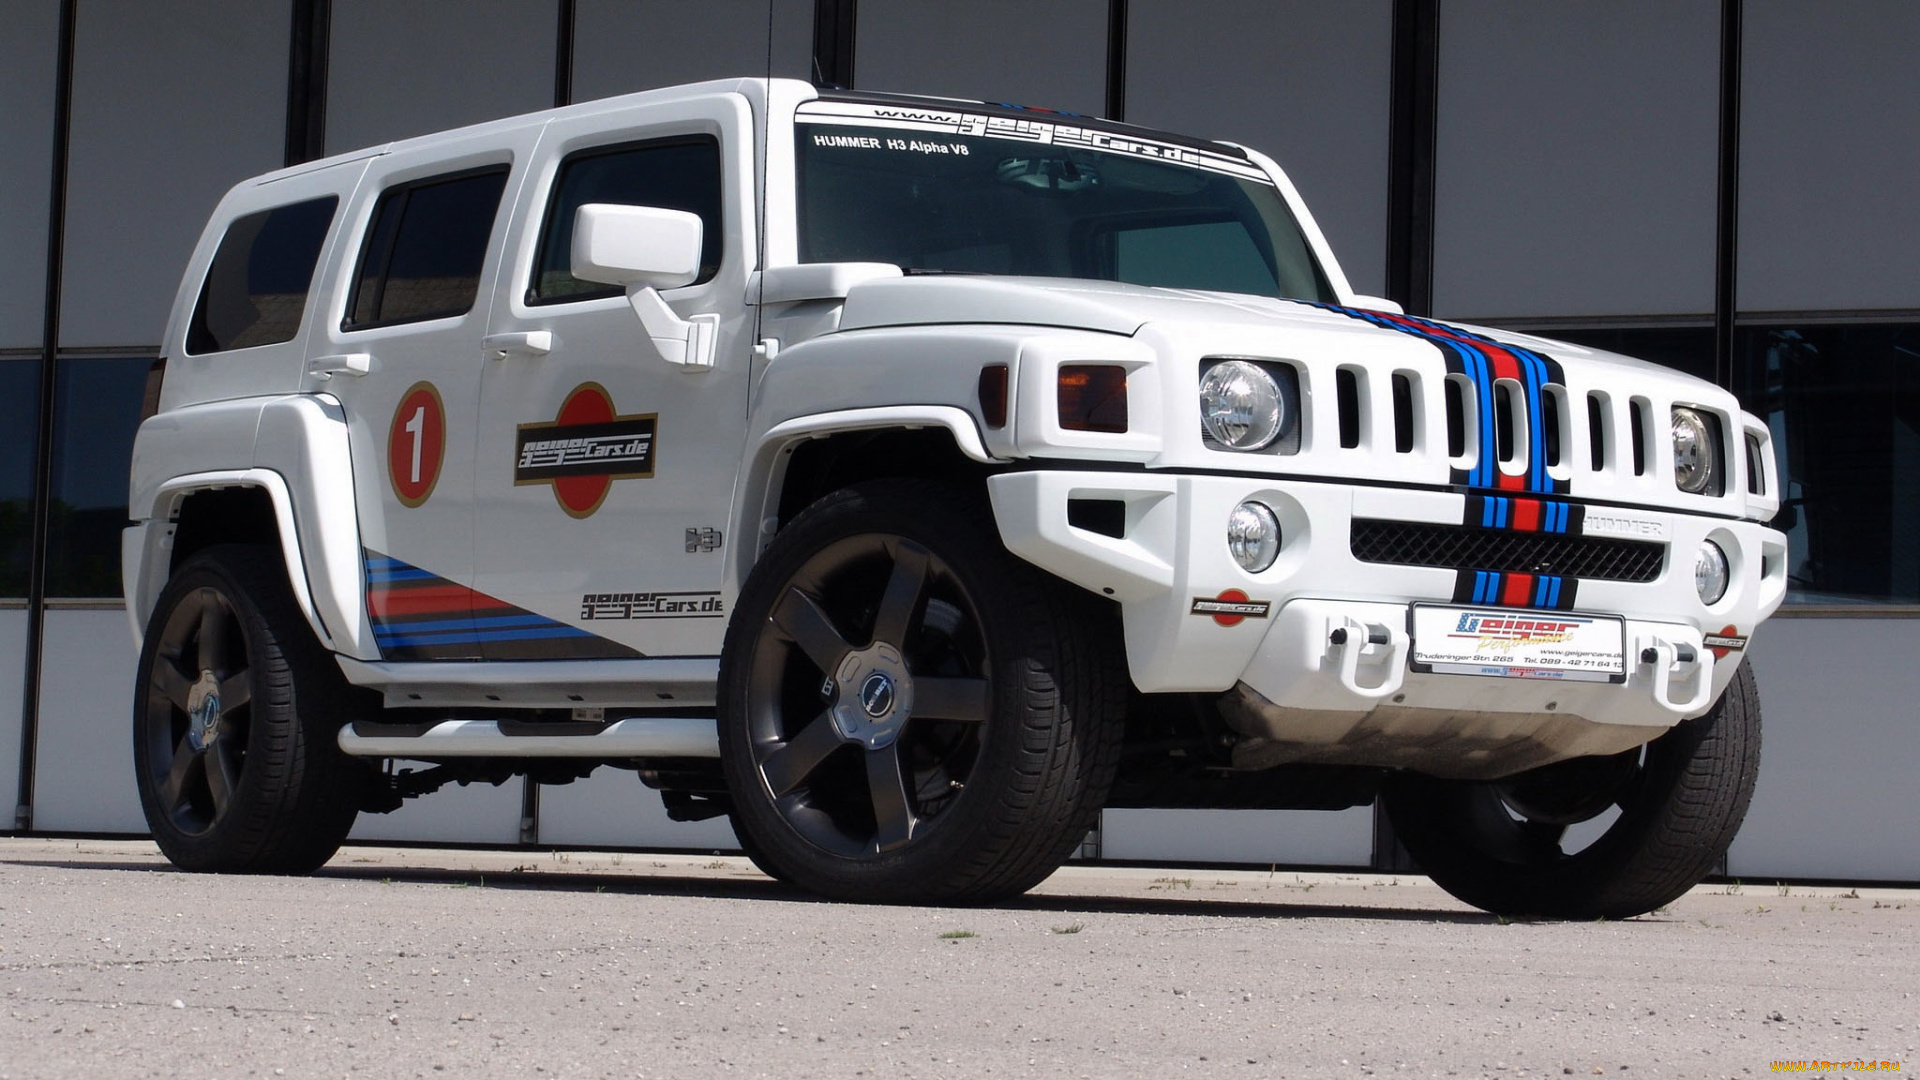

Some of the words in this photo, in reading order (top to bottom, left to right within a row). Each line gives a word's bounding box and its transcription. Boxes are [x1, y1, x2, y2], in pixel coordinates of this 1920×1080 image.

[814, 135, 882, 149] HUMMER
[887, 139, 906, 150] H3
[909, 140, 949, 155] Alpha
[950, 143, 969, 156] V8
[405, 406, 424, 483] 1
[1415, 652, 1472, 661] Truderinger
